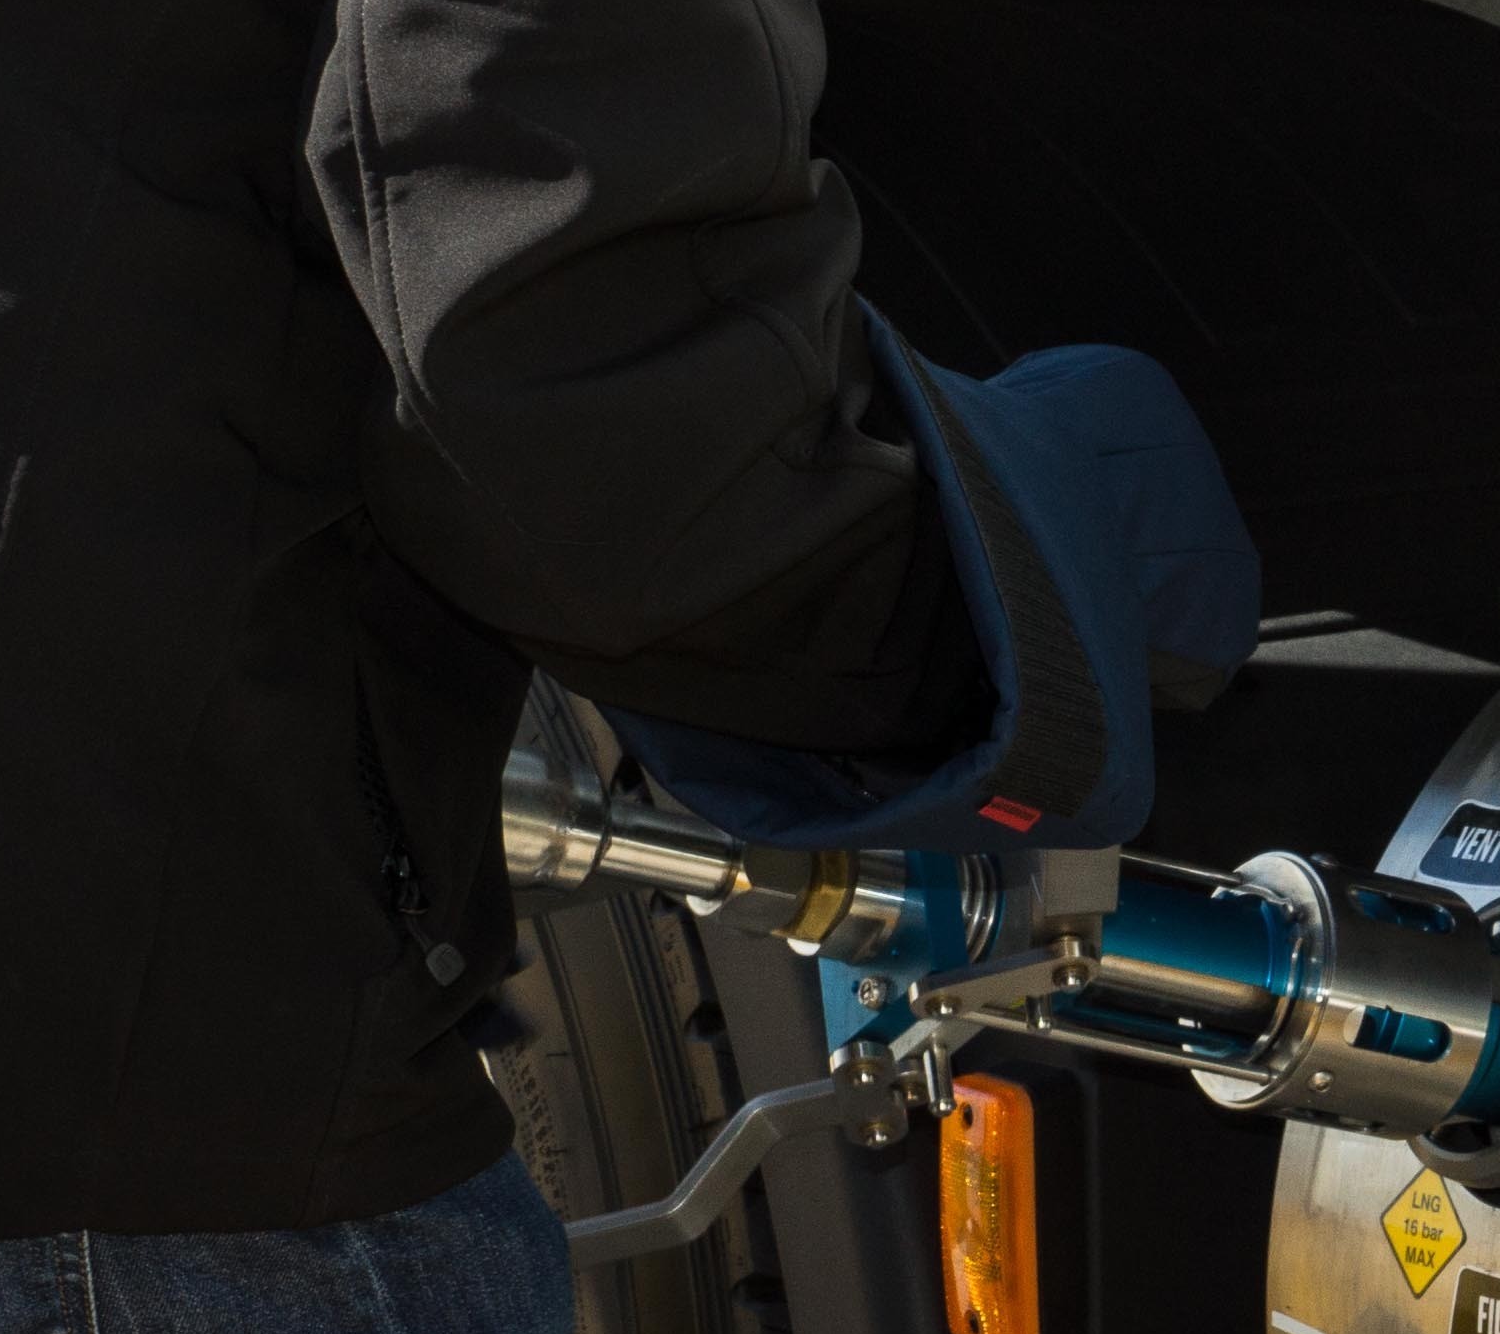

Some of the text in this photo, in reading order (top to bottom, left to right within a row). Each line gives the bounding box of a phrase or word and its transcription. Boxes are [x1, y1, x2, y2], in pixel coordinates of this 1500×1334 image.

[1411, 1191, 1441, 1212] LNG
[1404, 1218, 1443, 1241] 16 bar
[1405, 1246, 1435, 1268] MAX
